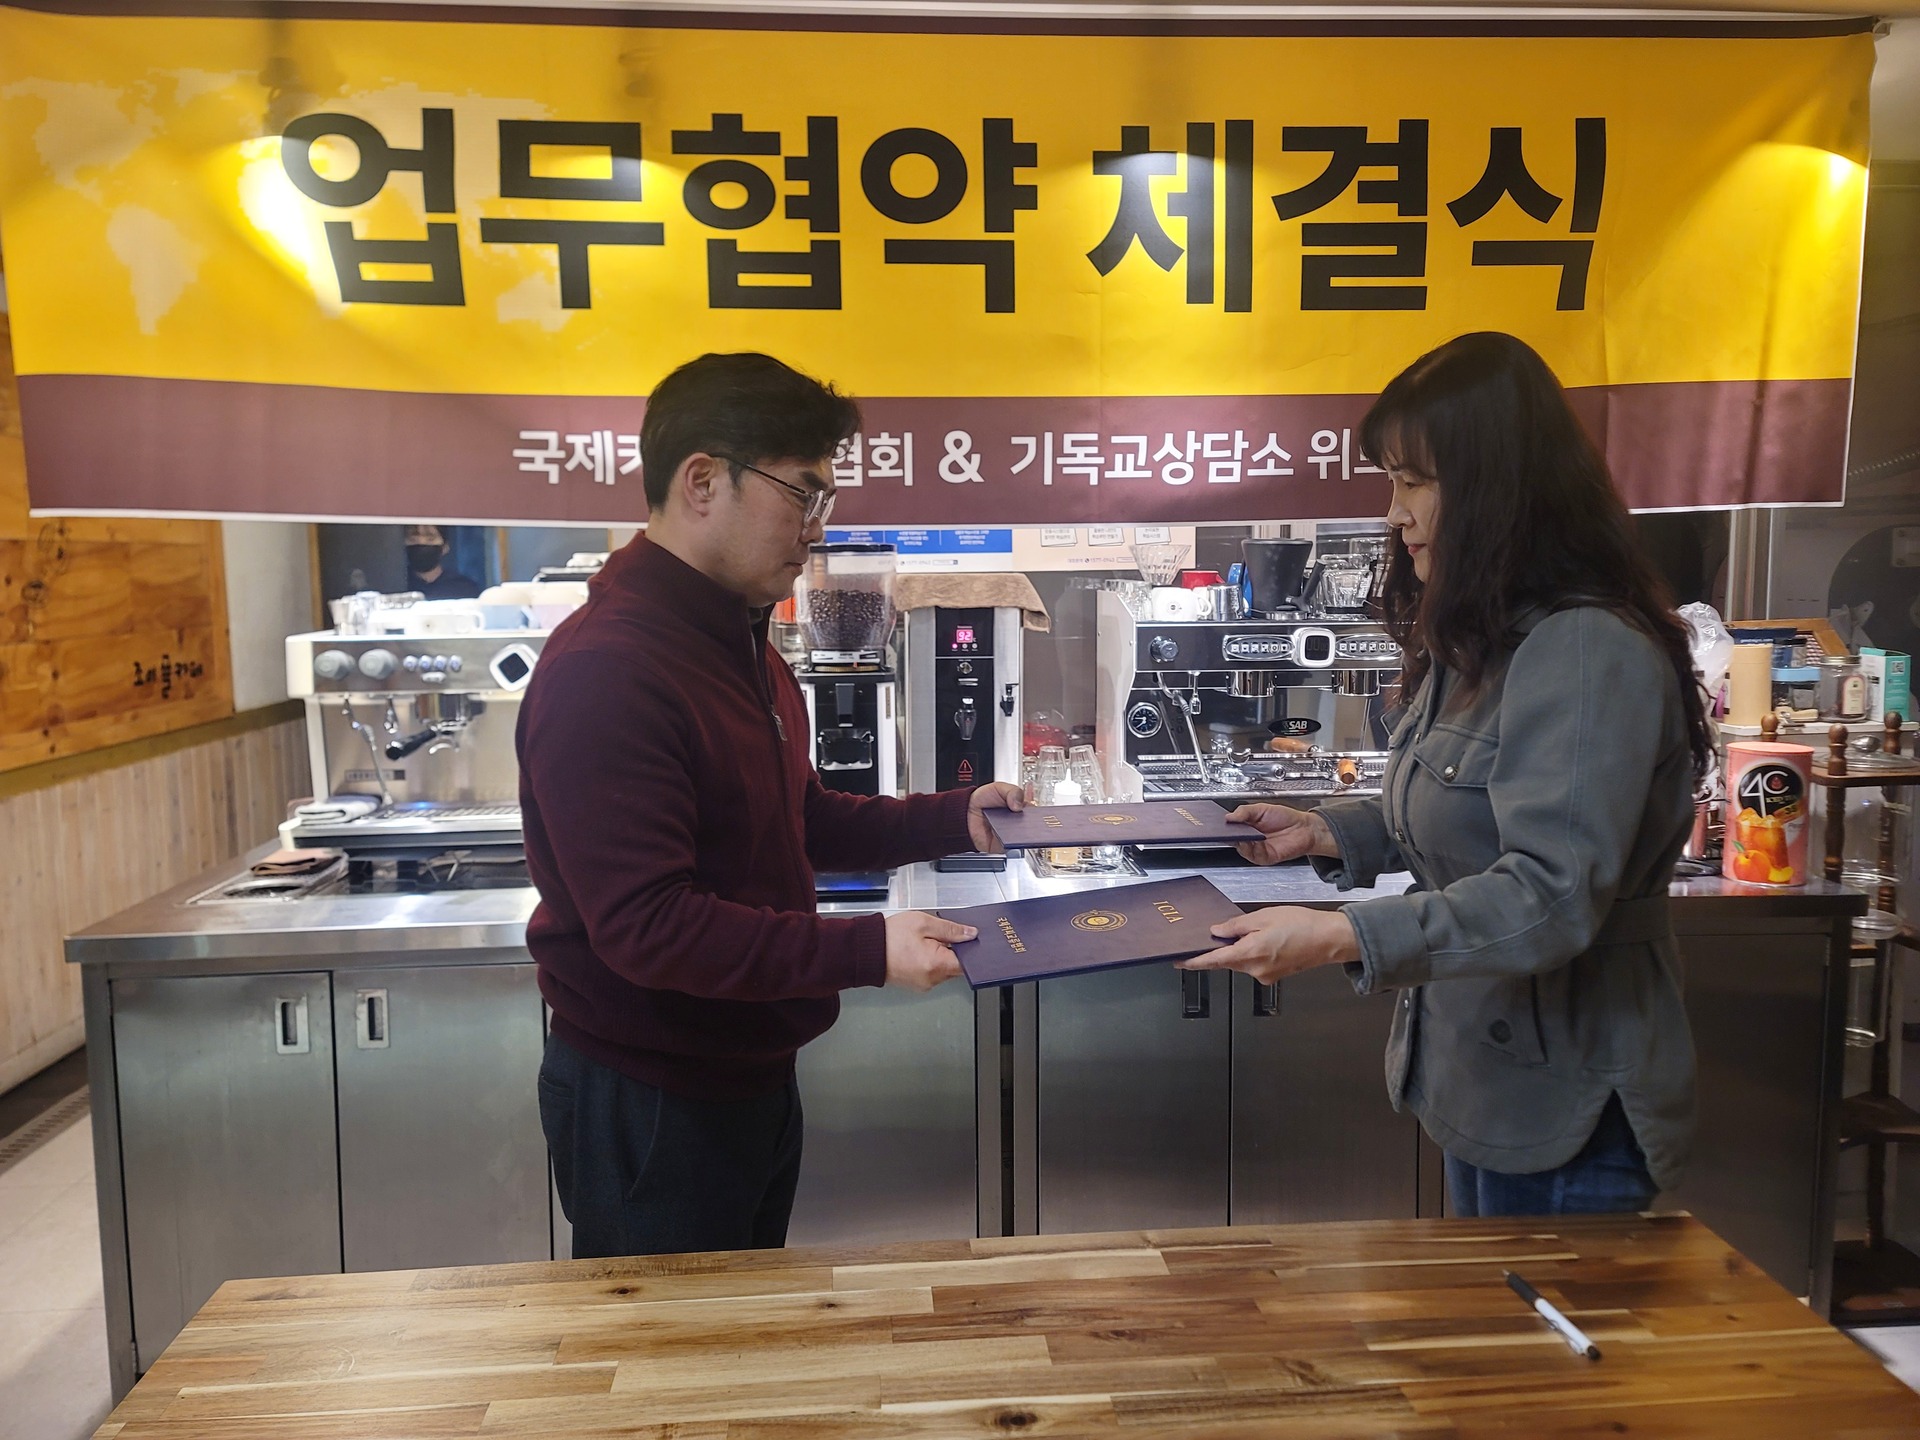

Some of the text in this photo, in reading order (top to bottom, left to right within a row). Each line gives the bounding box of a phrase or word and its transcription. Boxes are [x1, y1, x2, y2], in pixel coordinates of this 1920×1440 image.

[281, 108, 1606, 314] 업무협약 체결식
[938, 429, 985, 486] &
[1009, 428, 1295, 488] 기독교상담소
[958, 631, 971, 641] 92
[1288, 720, 1308, 730] SAB
[1741, 770, 1791, 819] 4C
[1152, 900, 1184, 924] ICIA
